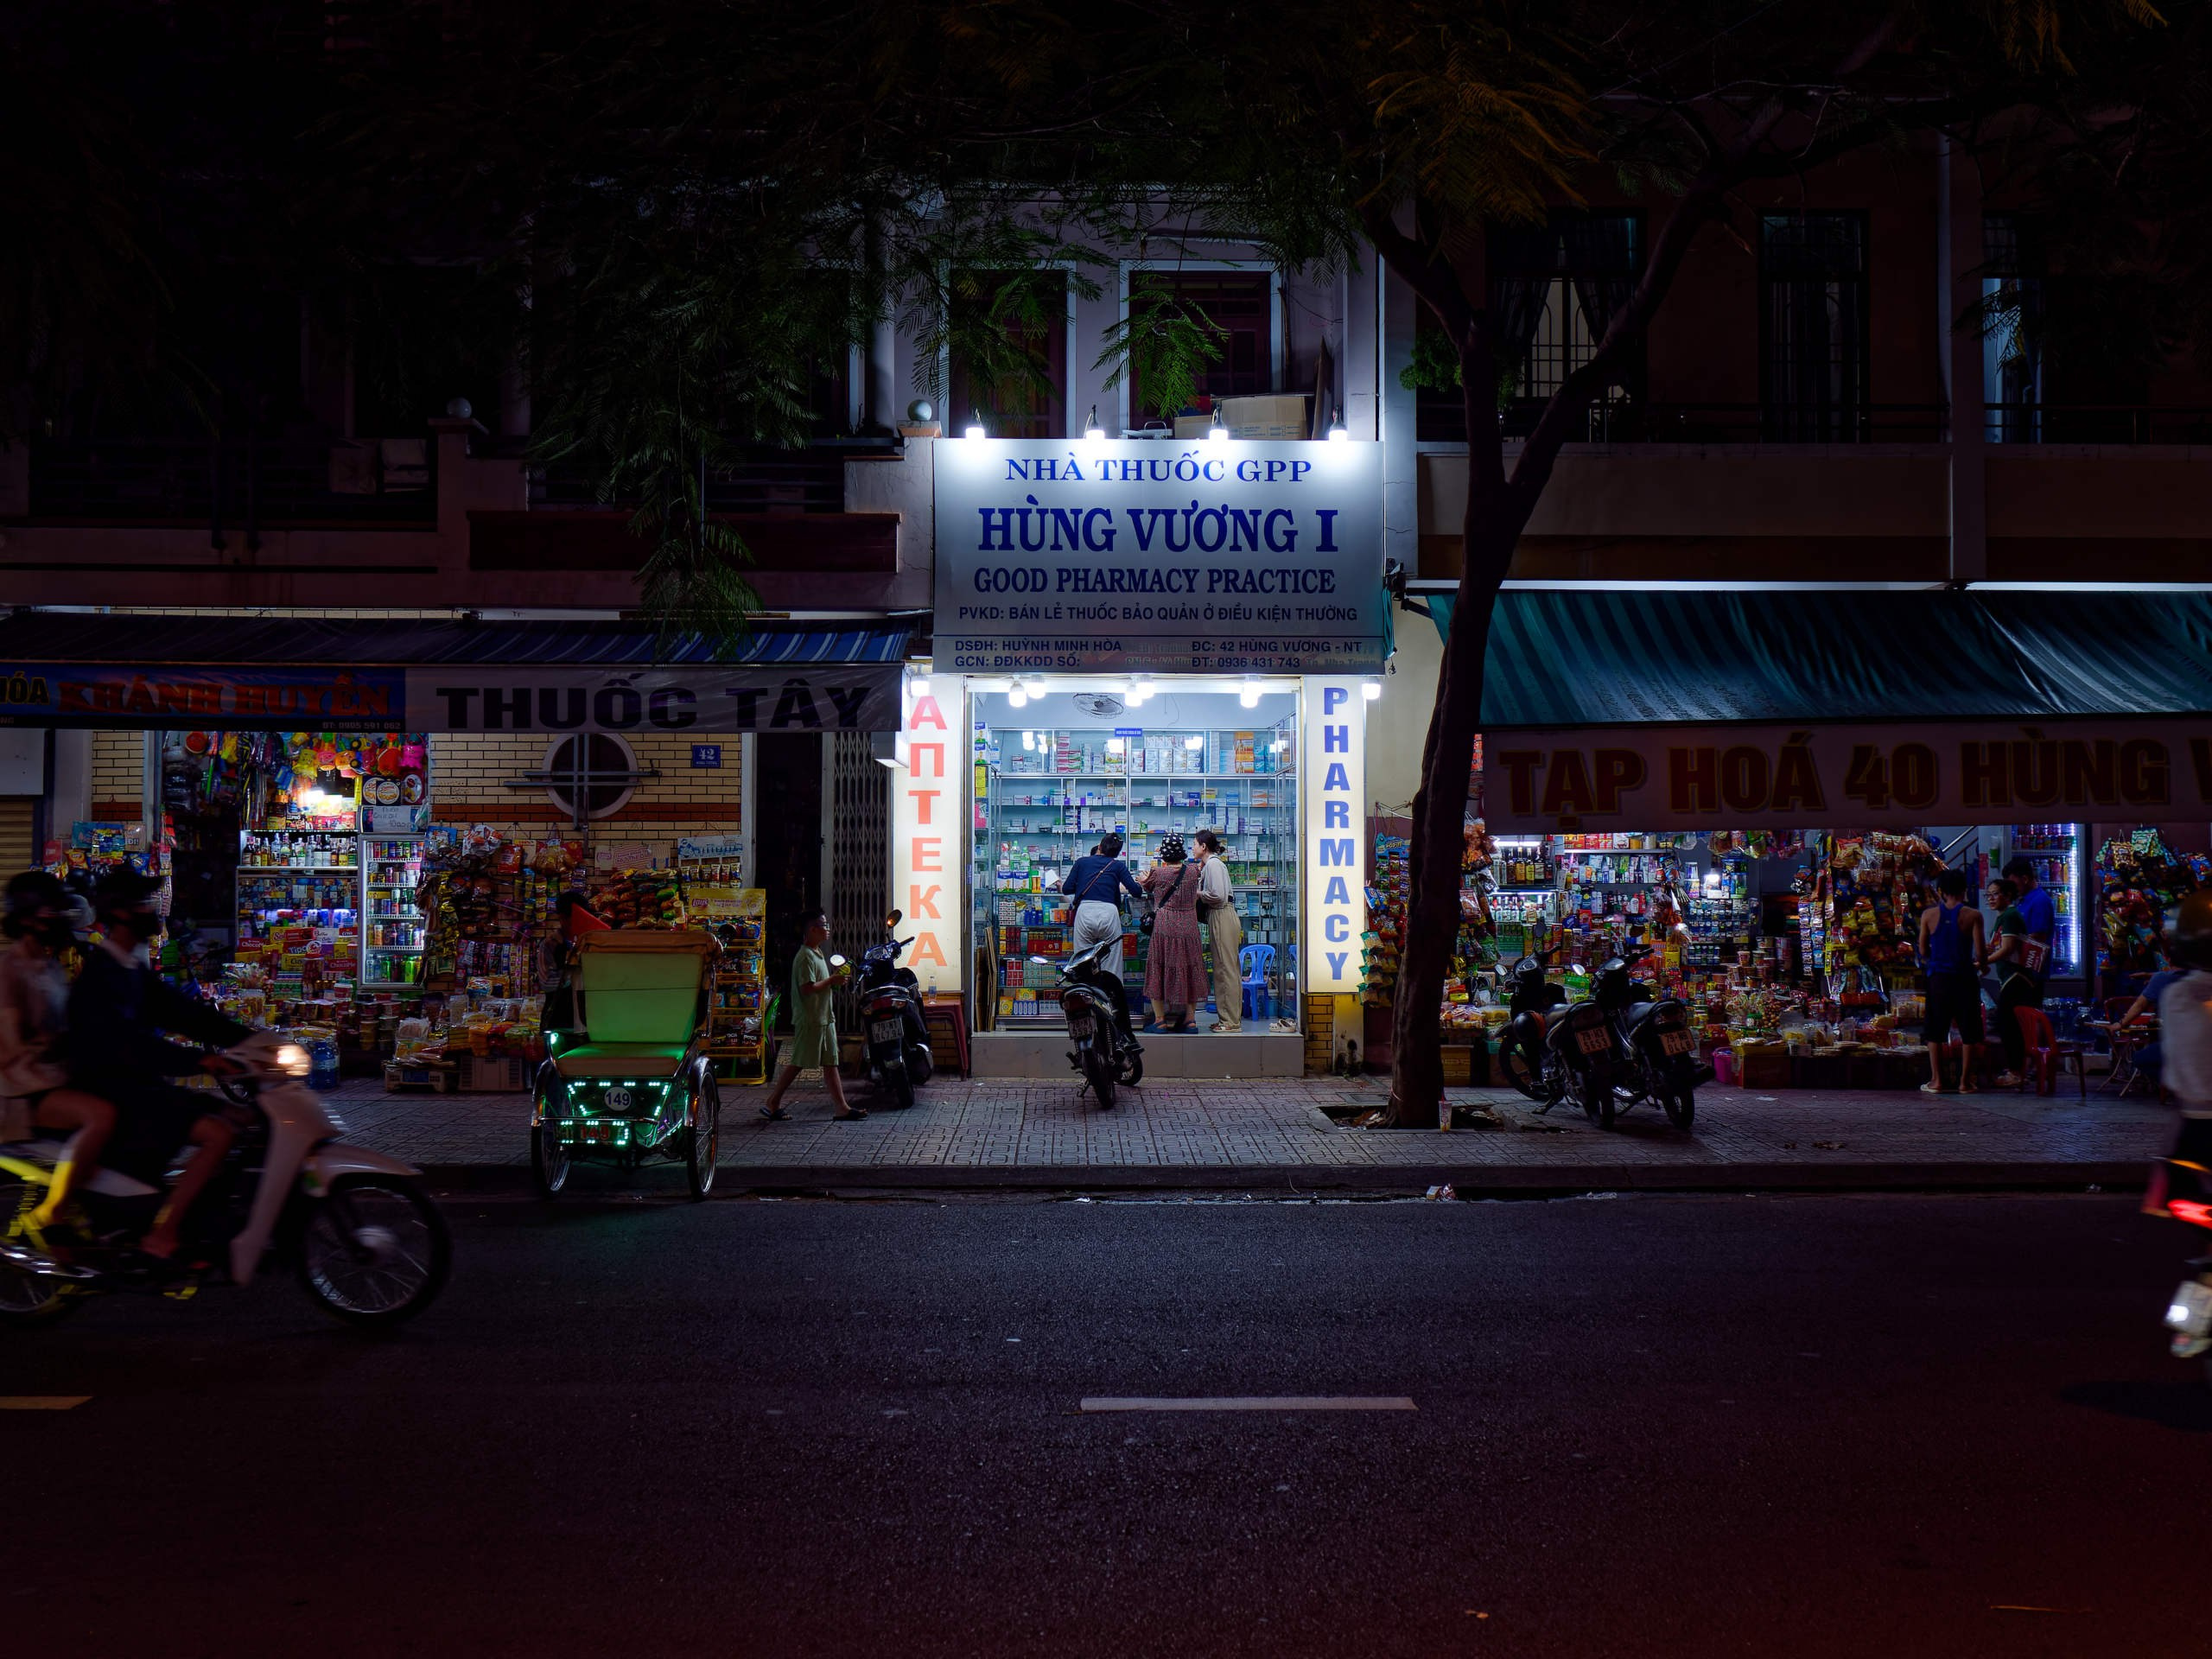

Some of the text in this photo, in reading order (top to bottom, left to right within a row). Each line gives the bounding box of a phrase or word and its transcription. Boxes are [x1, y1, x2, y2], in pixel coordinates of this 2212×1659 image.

[1006, 451, 1312, 481] NHÀ THUỐC GPP
[978, 494, 1338, 552] HÙNG VƯƠNG I
[975, 568, 1335, 594] GOOD PHARMACY PRACTICE
[959, 602, 1357, 623] PVKD: BÁN LẺ THUỐC BẢO QUẢN Ở ĐIỀU KIỆN THƯỜNG
[955, 640, 997, 652] DSĐH:
[1002, 638, 1049, 652] HUỲNH
[1053, 640, 1089, 652] MINH
[1093, 638, 1122, 652] HÒA
[1192, 640, 1216, 652] ĐC:
[1220, 641, 1235, 652] 42
[1239, 638, 1276, 652] HÙNG
[1282, 640, 1332, 652] VƯƠNG
[1344, 641, 1363, 652] NT
[955, 652, 1080, 667] GCN: ĐĐKKDD SỐ:
[1192, 657, 1213, 668] ĐT:
[1217, 657, 1249, 668] 0936
[1252, 657, 1277, 668] 431
[1280, 657, 1300, 668] 743
[59, 675, 222, 714] KHÁNH
[235, 671, 390, 716] HUYỀN
[436, 673, 872, 728] THUỐC TÂY
[1499, 749, 1646, 826] TẠP
[1669, 731, 1826, 813] HOÁ
[1845, 742, 1939, 810] 40
[1961, 727, 2171, 808] HÙNG
[907, 696, 947, 966] АПТЕКА
[1320, 688, 1354, 979] PHARMACY
[606, 1092, 630, 1106] 149
[580, 1125, 609, 1140] 149
